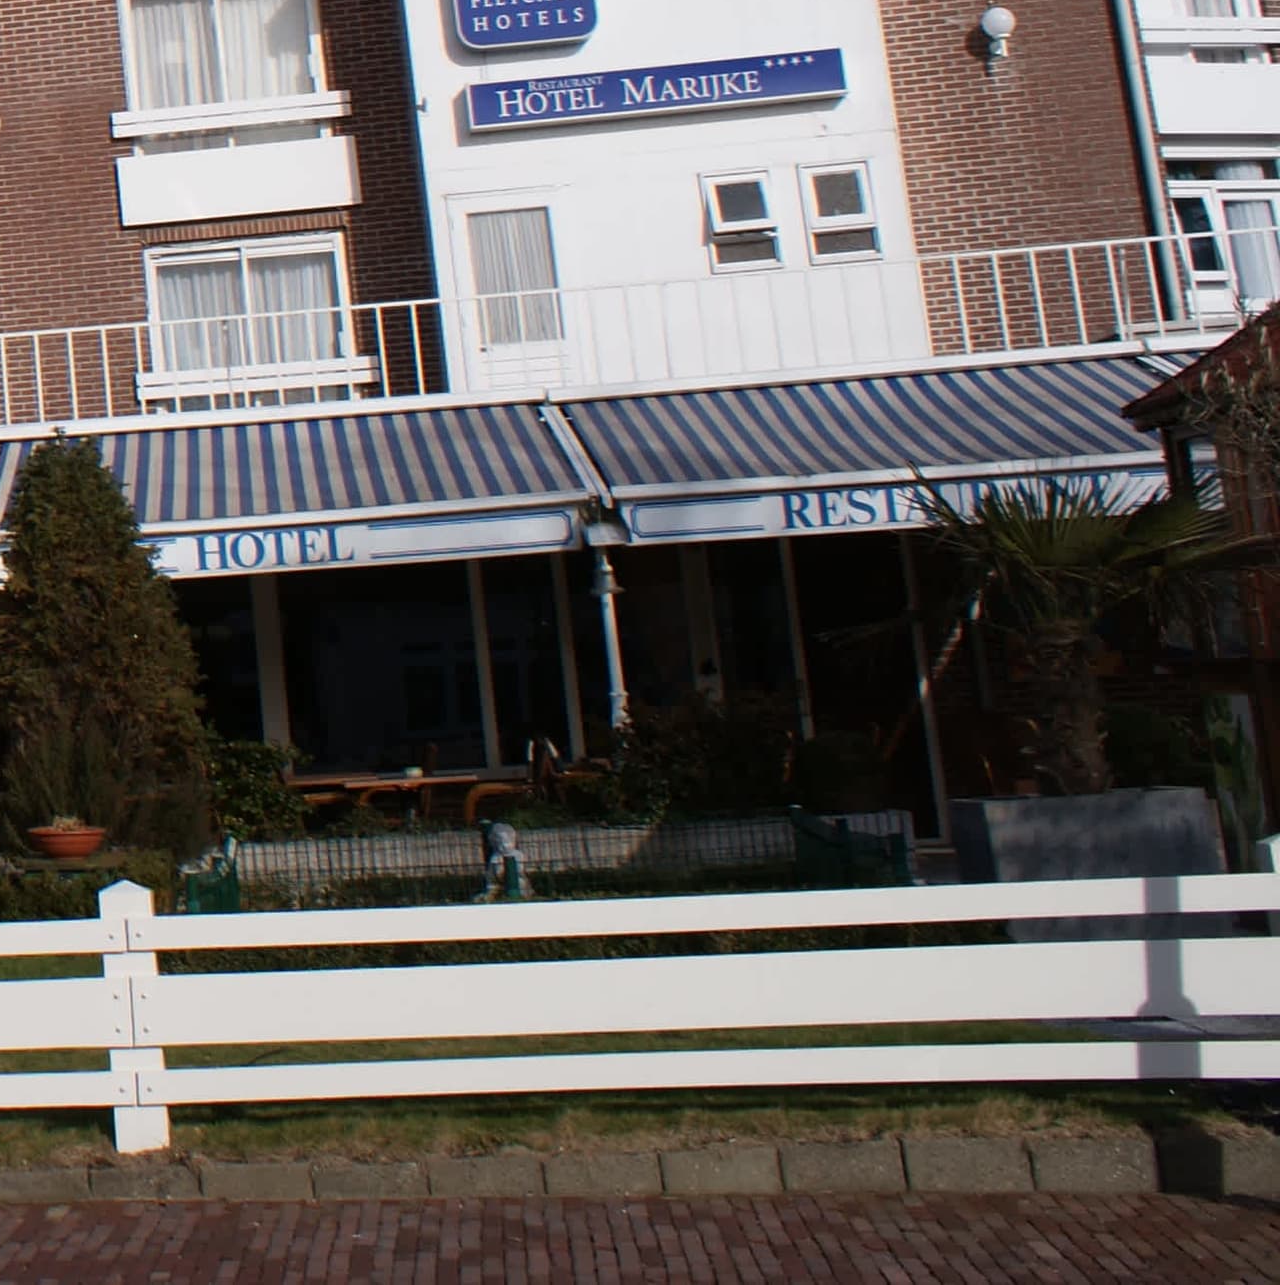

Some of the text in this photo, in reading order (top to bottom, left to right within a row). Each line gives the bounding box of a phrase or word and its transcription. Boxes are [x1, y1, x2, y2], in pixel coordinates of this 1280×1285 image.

[472, 7, 585, 32] HOTELS
[495, 70, 762, 118] HOTEL MARIJKE
[194, 525, 355, 571] HOTEL
